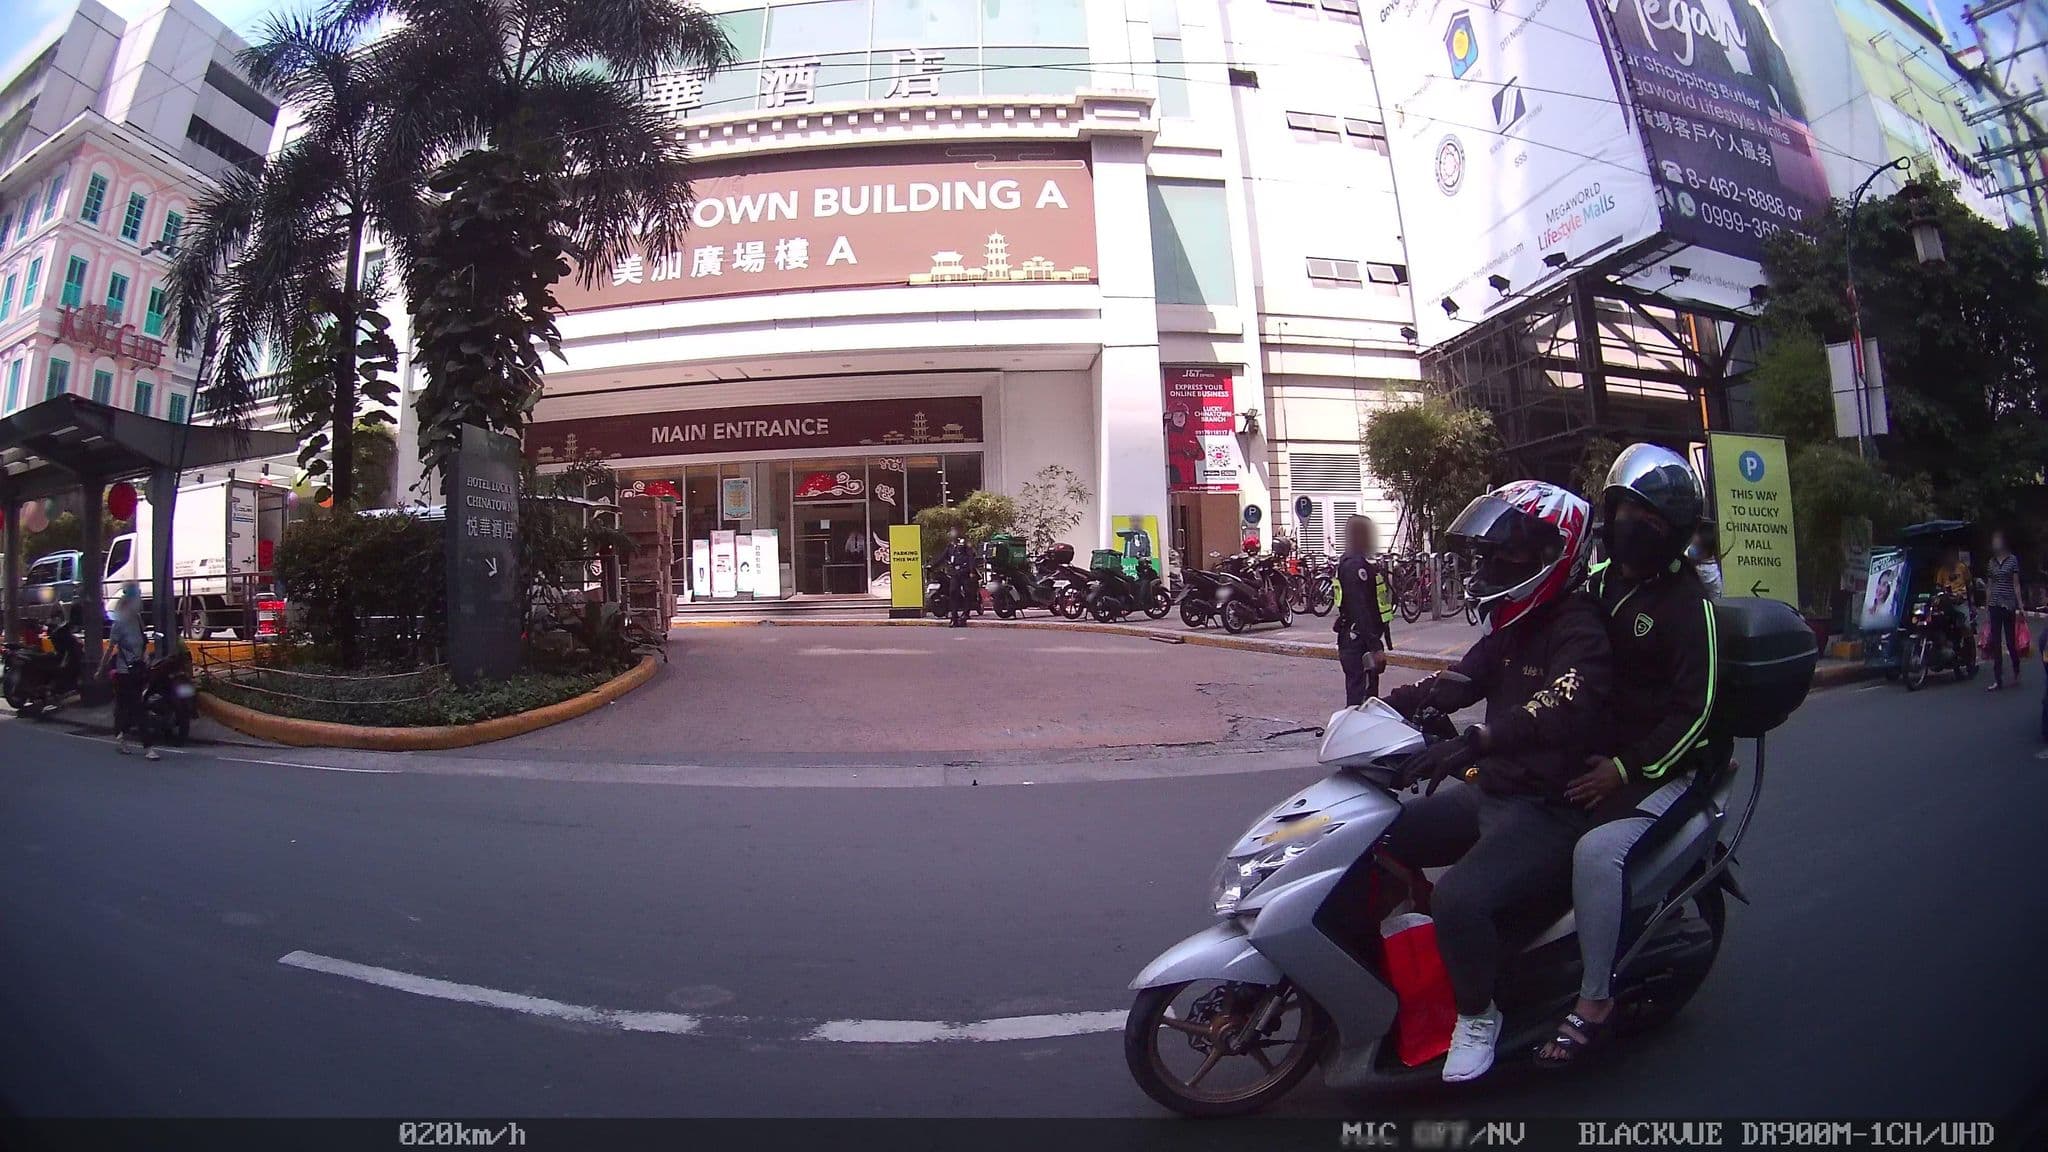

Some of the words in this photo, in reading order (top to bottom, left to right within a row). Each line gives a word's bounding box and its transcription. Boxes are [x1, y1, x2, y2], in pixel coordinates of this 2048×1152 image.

[1642, 56, 1721, 100] Shopping
[813, 179, 1022, 218] BUILDING
[1034, 179, 1069, 210] A
[1684, 167, 1787, 219] 8-462-8888
[1545, 182, 1601, 225] MEGAWORLD
[1537, 213, 1583, 252] Lifestyle
[1582, 193, 1616, 225] Malls
[826, 236, 859, 267] A
[1175, 383, 1202, 391] EXPRESS
[1197, 390, 1230, 398] BUSINESS
[652, 424, 706, 443] MAIN
[713, 418, 829, 440] ENTRANCE
[467, 476, 491, 491] HOTEL
[1730, 488, 1754, 500] THIS
[1755, 491, 1778, 502] WAY
[466, 495, 513, 513] CHINATOWN
[1731, 505, 1746, 516] TO
[1748, 507, 1779, 518] LUCKY
[1725, 521, 1788, 535] CHINATOWN
[1744, 539, 1772, 550] MALL
[1737, 555, 1782, 567] PARKING
